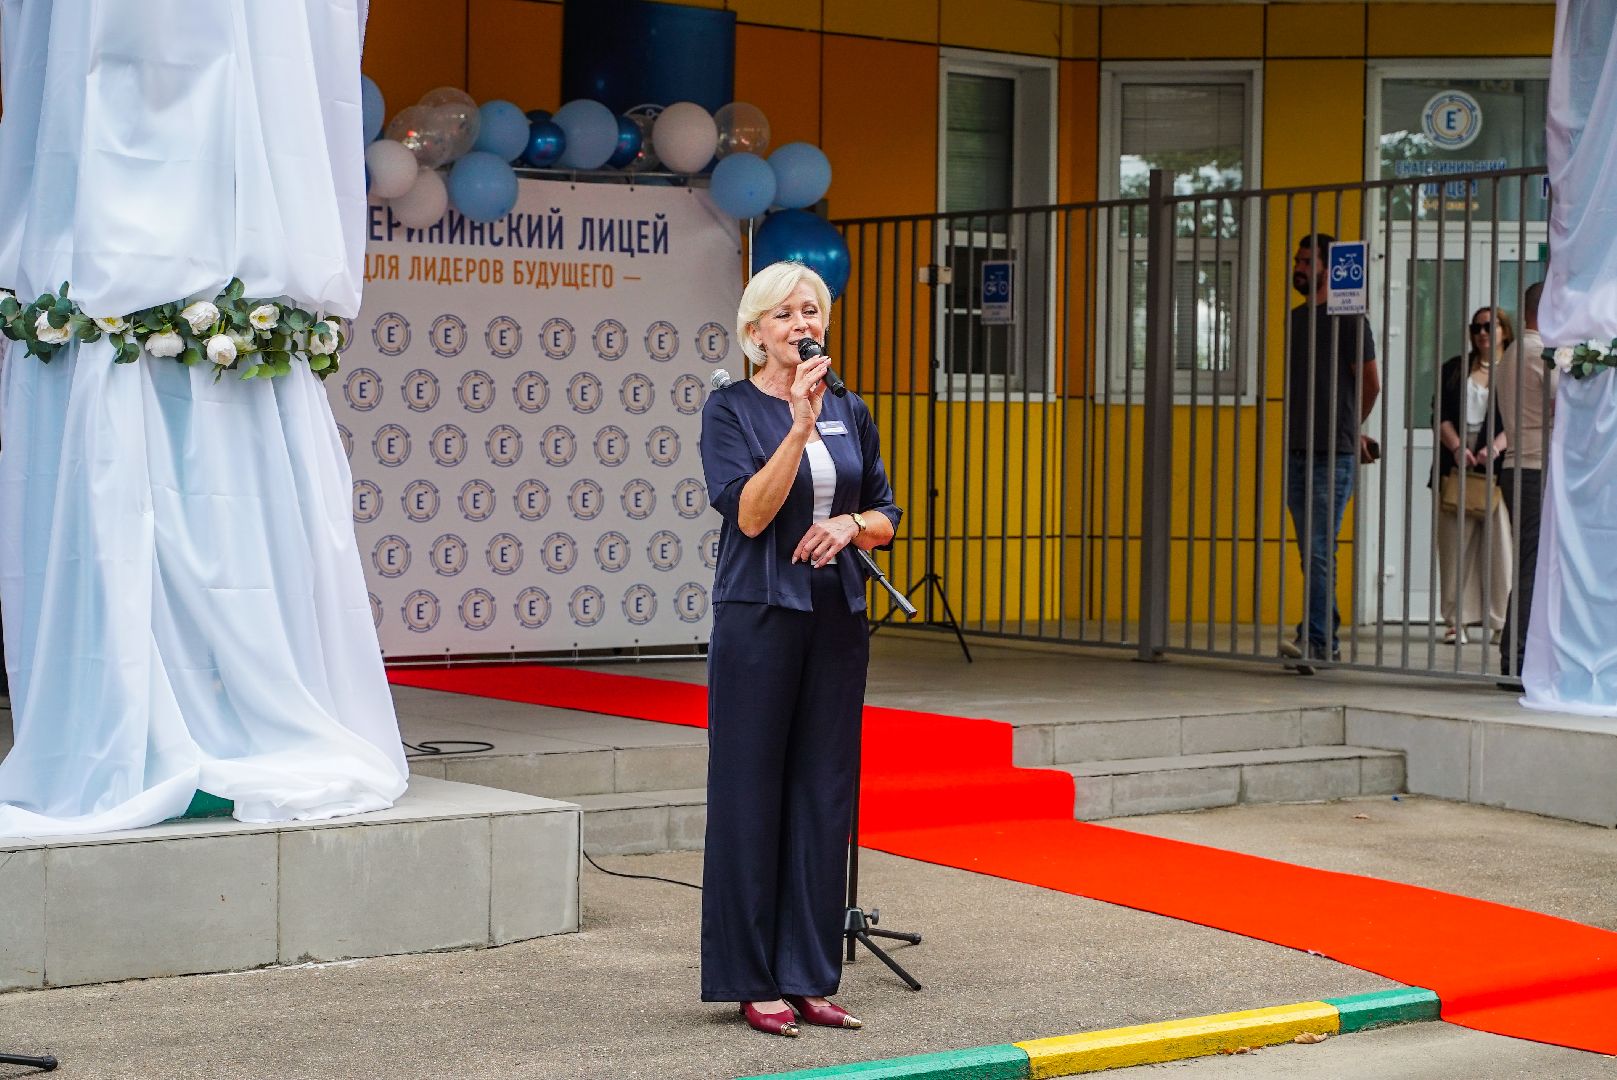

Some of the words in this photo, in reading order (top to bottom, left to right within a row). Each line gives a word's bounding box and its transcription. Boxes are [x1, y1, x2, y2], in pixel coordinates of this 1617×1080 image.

[1446, 111, 1456, 130] Е
[578, 203, 668, 258] ЛИЦЕЙ
[408, 255, 503, 286] ЛИДЕРОВ
[513, 259, 614, 290] БУДУЩЕГО
[388, 326, 395, 343] Е
[444, 328, 452, 344] Е
[500, 330, 507, 346] Е
[553, 331, 561, 348] Е
[606, 332, 614, 349] Е
[658, 334, 665, 350] Е
[709, 335, 716, 351] Е
[359, 382, 367, 399] Е
[417, 383, 424, 400] Е
[473, 384, 480, 400] Е
[528, 385, 535, 401] Е
[581, 385, 588, 402] Е
[633, 386, 640, 402] Е
[685, 387, 692, 403] Е
[388, 438, 396, 454] Е
[445, 438, 452, 454] Е
[500, 438, 507, 455] Е
[554, 438, 561, 455] Е
[608, 439, 615, 455] Е
[660, 439, 666, 455] Е
[359, 494, 367, 510] Е
[417, 493, 424, 510] Е
[473, 493, 481, 509] Е
[528, 493, 535, 509] Е
[582, 492, 589, 508] Е
[635, 492, 642, 508] Е
[686, 491, 693, 507] Е
[388, 549, 395, 565] Е
[445, 548, 452, 564] Е
[501, 547, 508, 563] Е
[555, 546, 562, 562] Е
[609, 545, 616, 561] Е
[661, 544, 668, 559] Е
[712, 542, 719, 558] Е
[473, 602, 481, 618] Е
[529, 600, 536, 616] Е
[583, 599, 590, 615] Е
[636, 597, 643, 613] Е
[687, 595, 694, 611] Е
[417, 604, 425, 620] Е
